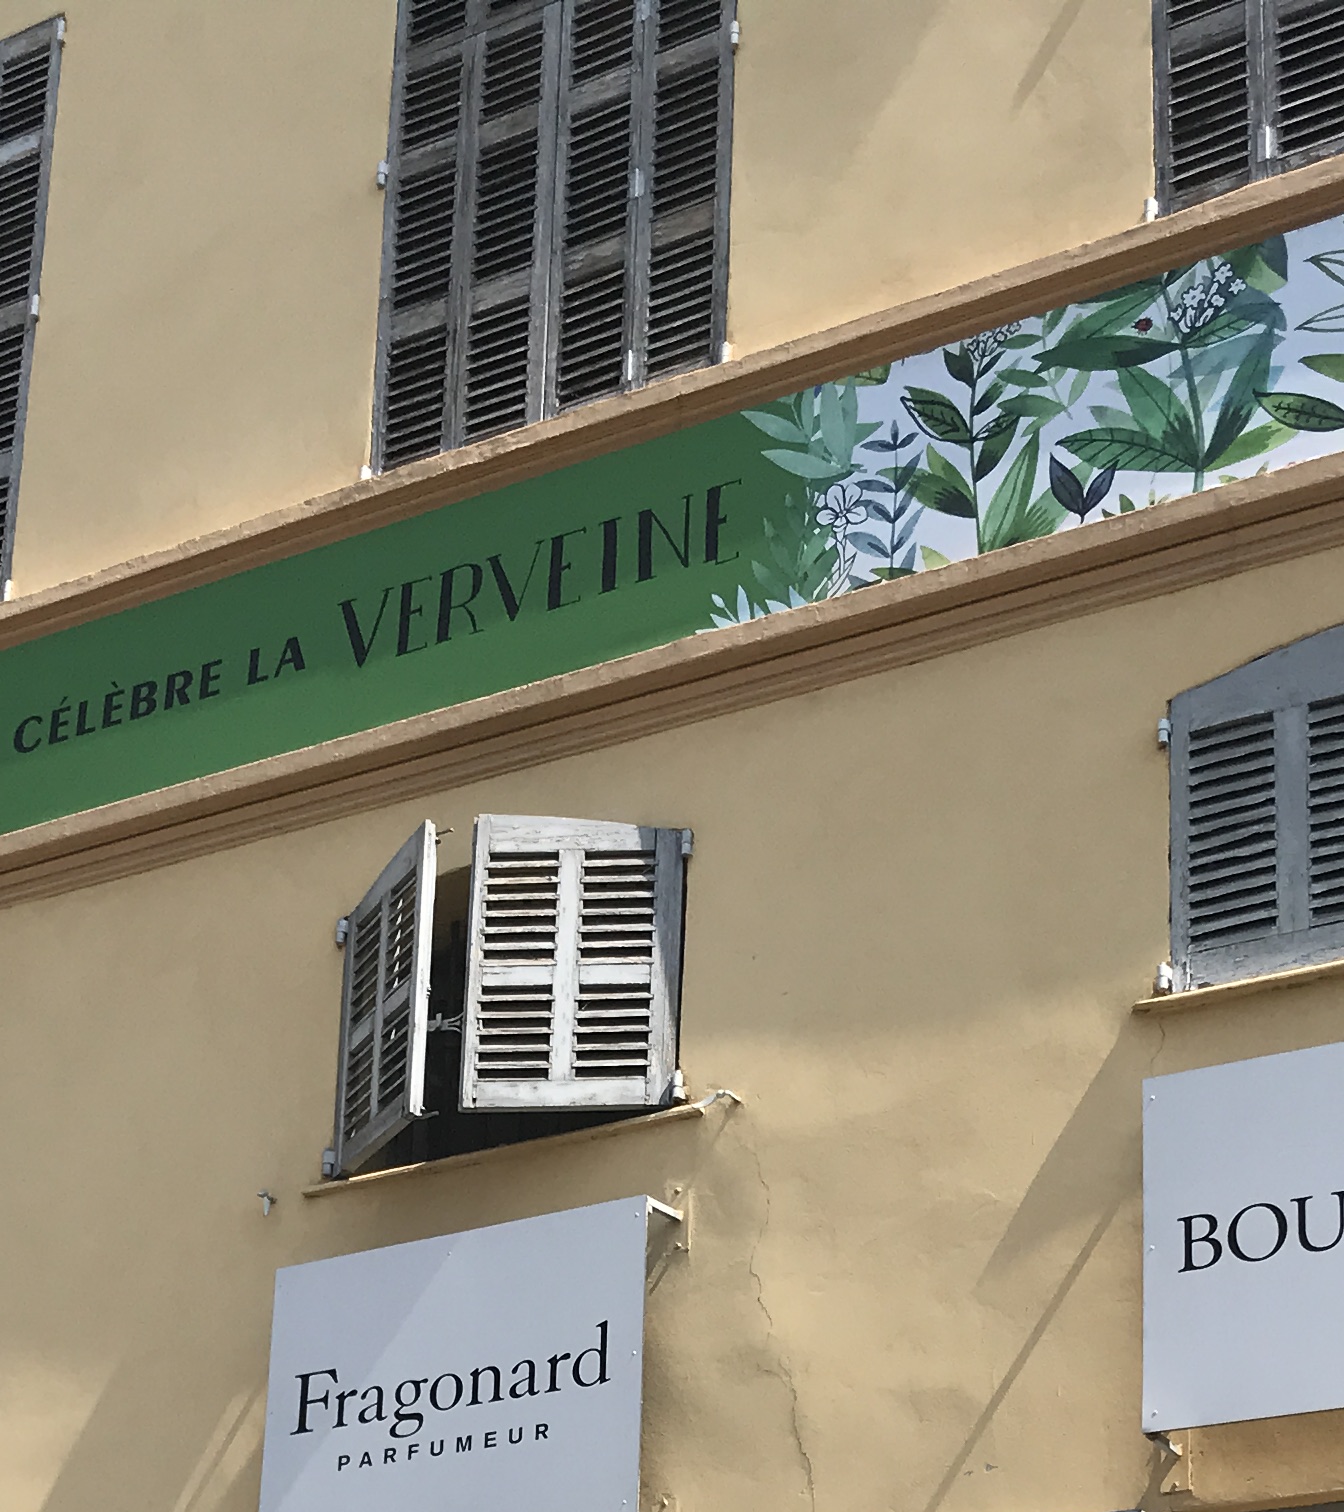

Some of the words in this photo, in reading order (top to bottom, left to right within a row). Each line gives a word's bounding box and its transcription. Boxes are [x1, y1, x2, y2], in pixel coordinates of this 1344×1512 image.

[13, 658, 223, 754] CÉLÈBRE
[246, 635, 306, 686] LA
[337, 478, 742, 669] VERVEINE
[289, 1319, 611, 1440] Fragonard
[336, 1422, 551, 1473] PARFUMEUR
